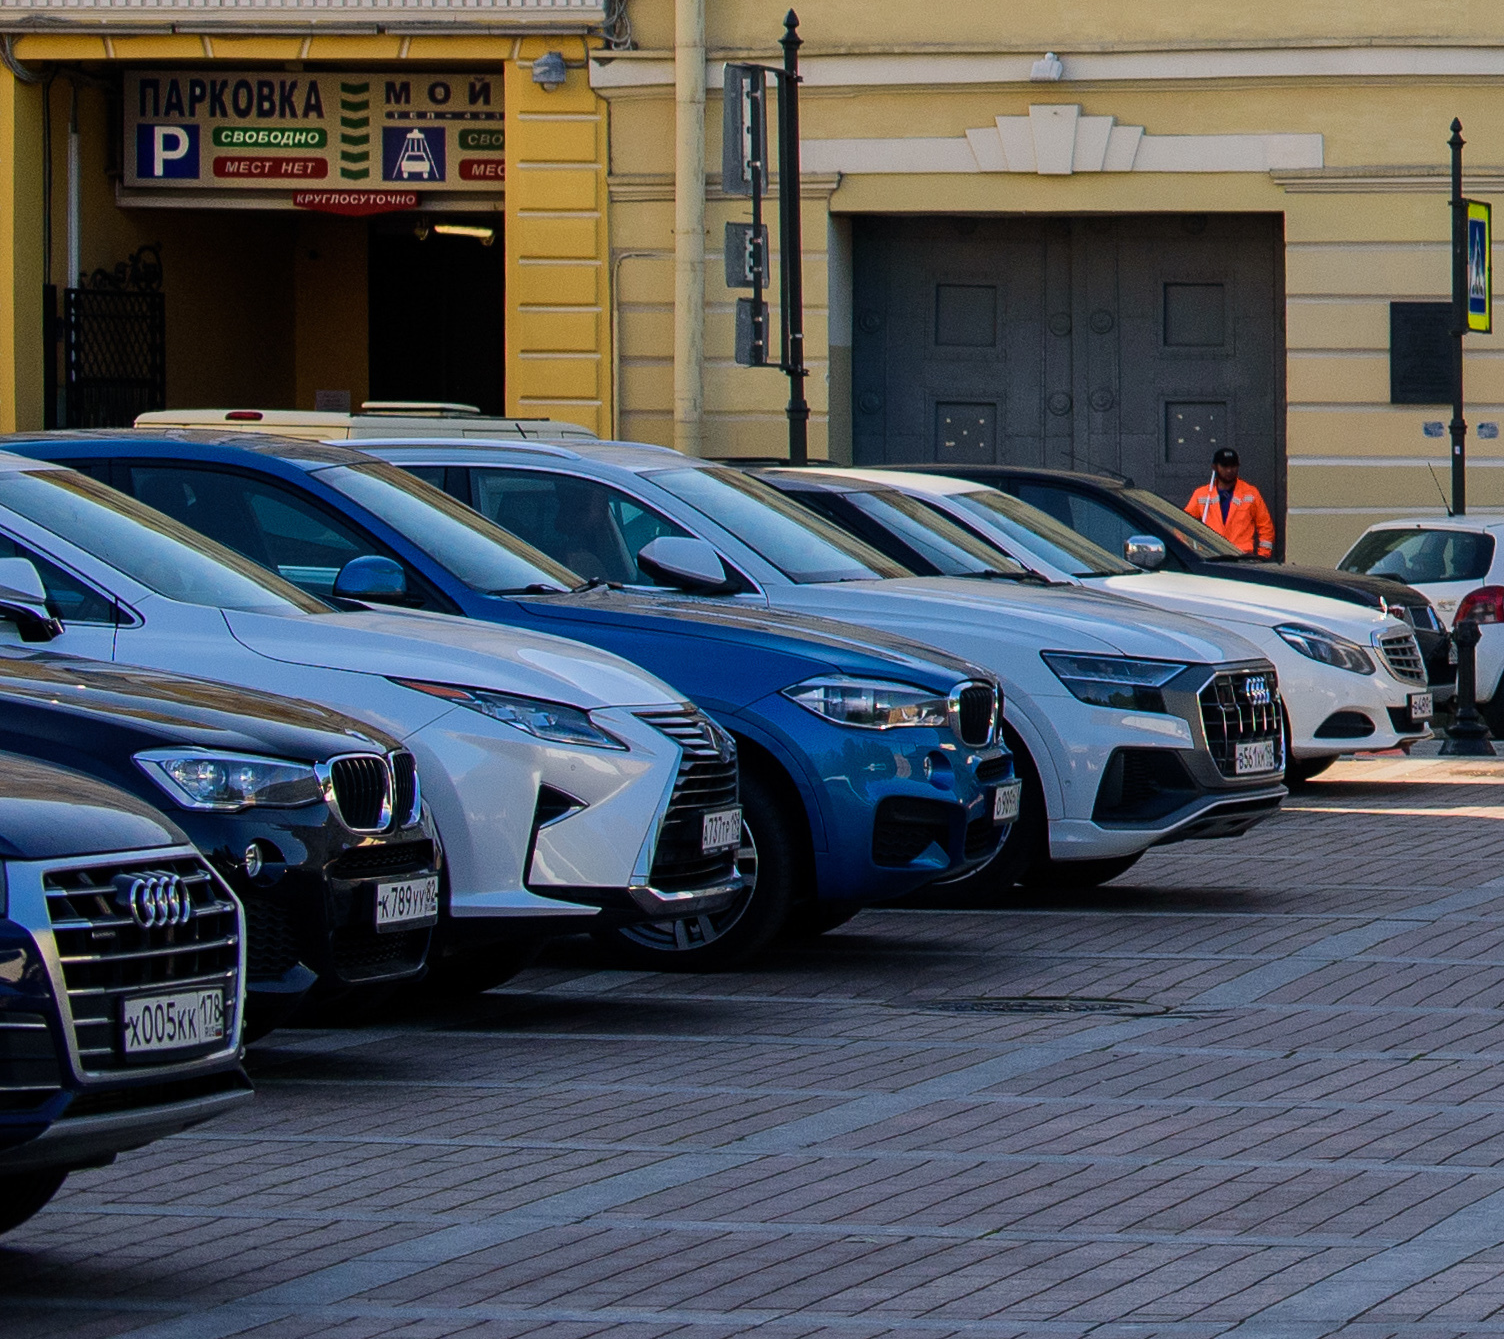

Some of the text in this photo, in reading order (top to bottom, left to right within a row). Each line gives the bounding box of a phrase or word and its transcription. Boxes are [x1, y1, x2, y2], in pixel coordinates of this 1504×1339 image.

[138, 78, 325, 120] ПАРКОВКА
[220, 130, 321, 145] СВОБОДНО
[224, 160, 316, 175] МЕСТ НЕТ
[296, 193, 416, 206] КРУГЛОСУТОЧНО
[129, 993, 222, 1048] Х005КК 178
